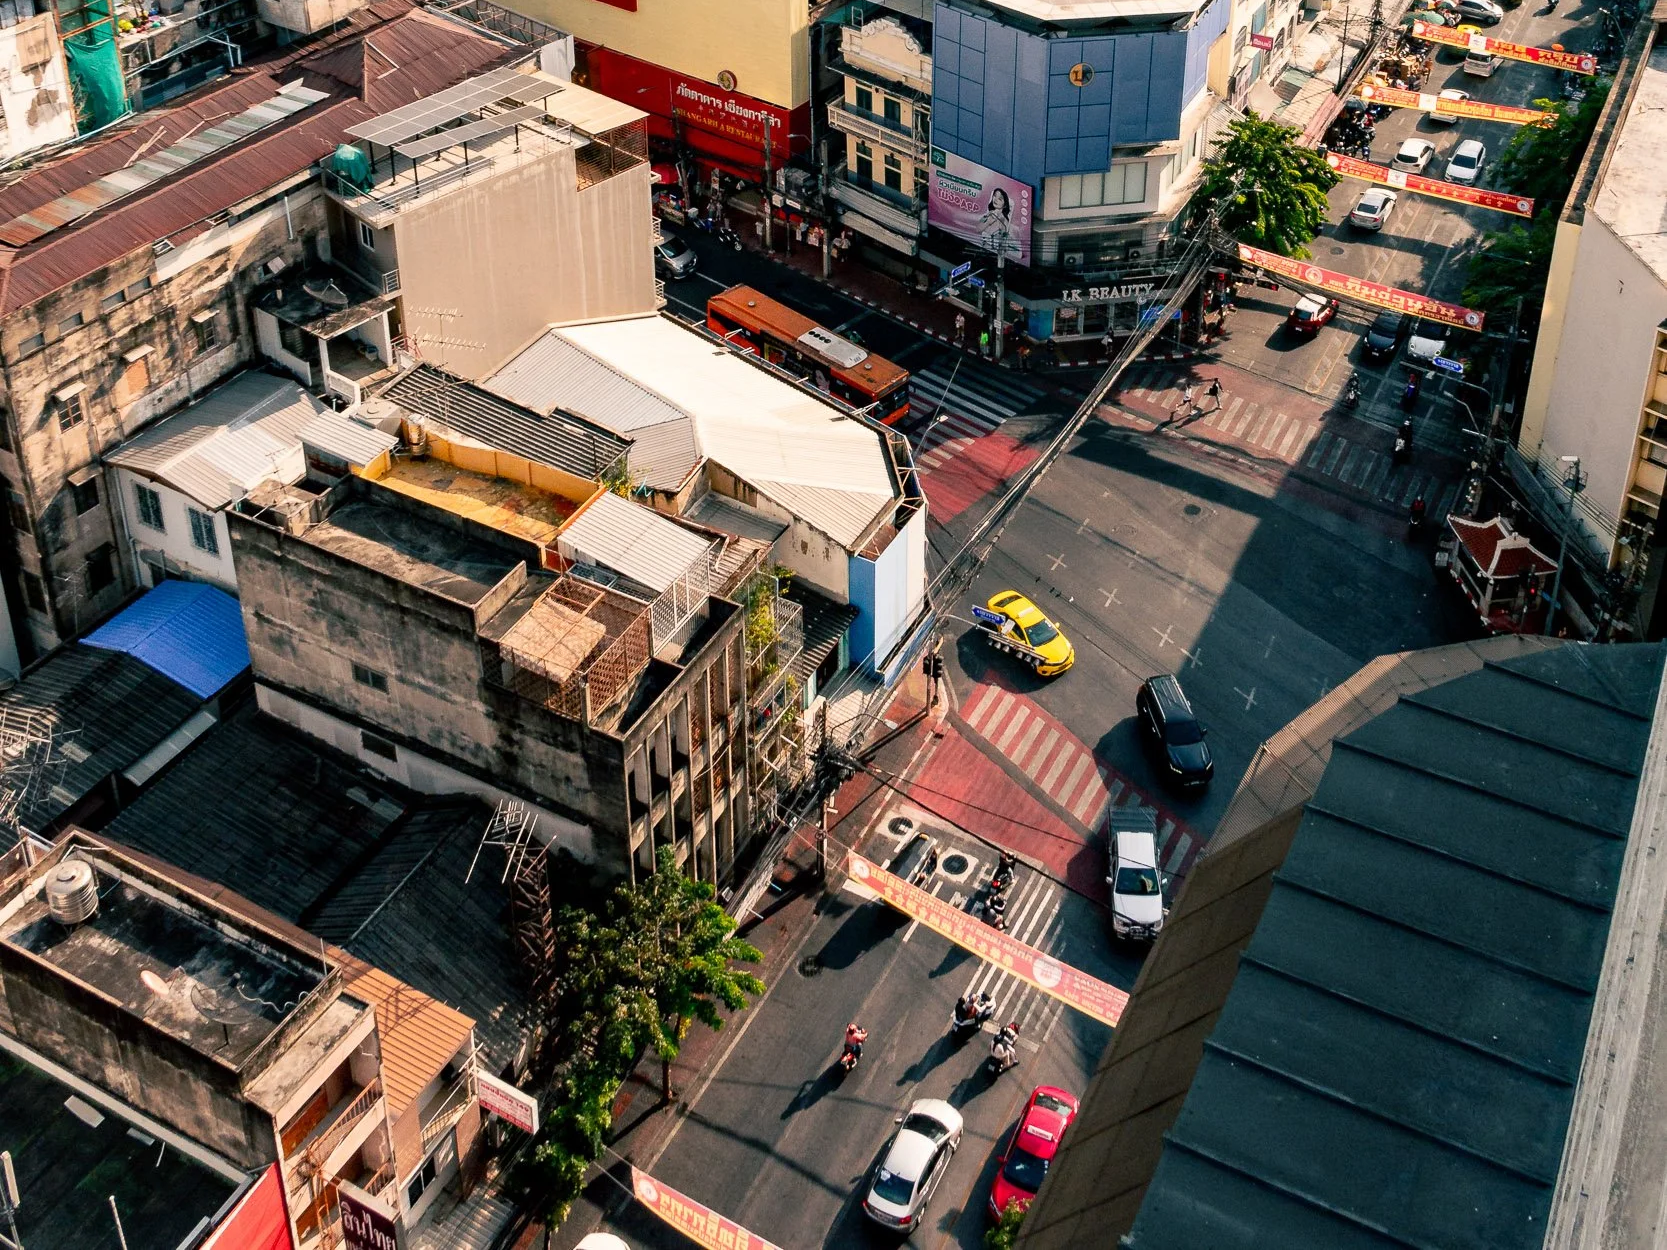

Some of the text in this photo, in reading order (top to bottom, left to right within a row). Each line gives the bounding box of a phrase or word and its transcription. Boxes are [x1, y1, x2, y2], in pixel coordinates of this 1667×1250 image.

[676, 82, 723, 108] ภัตตาคาร
[726, 125, 778, 149] RESTAURAT
[1062, 289, 1082, 303] LK
[1088, 283, 1155, 301] BEAUTY
